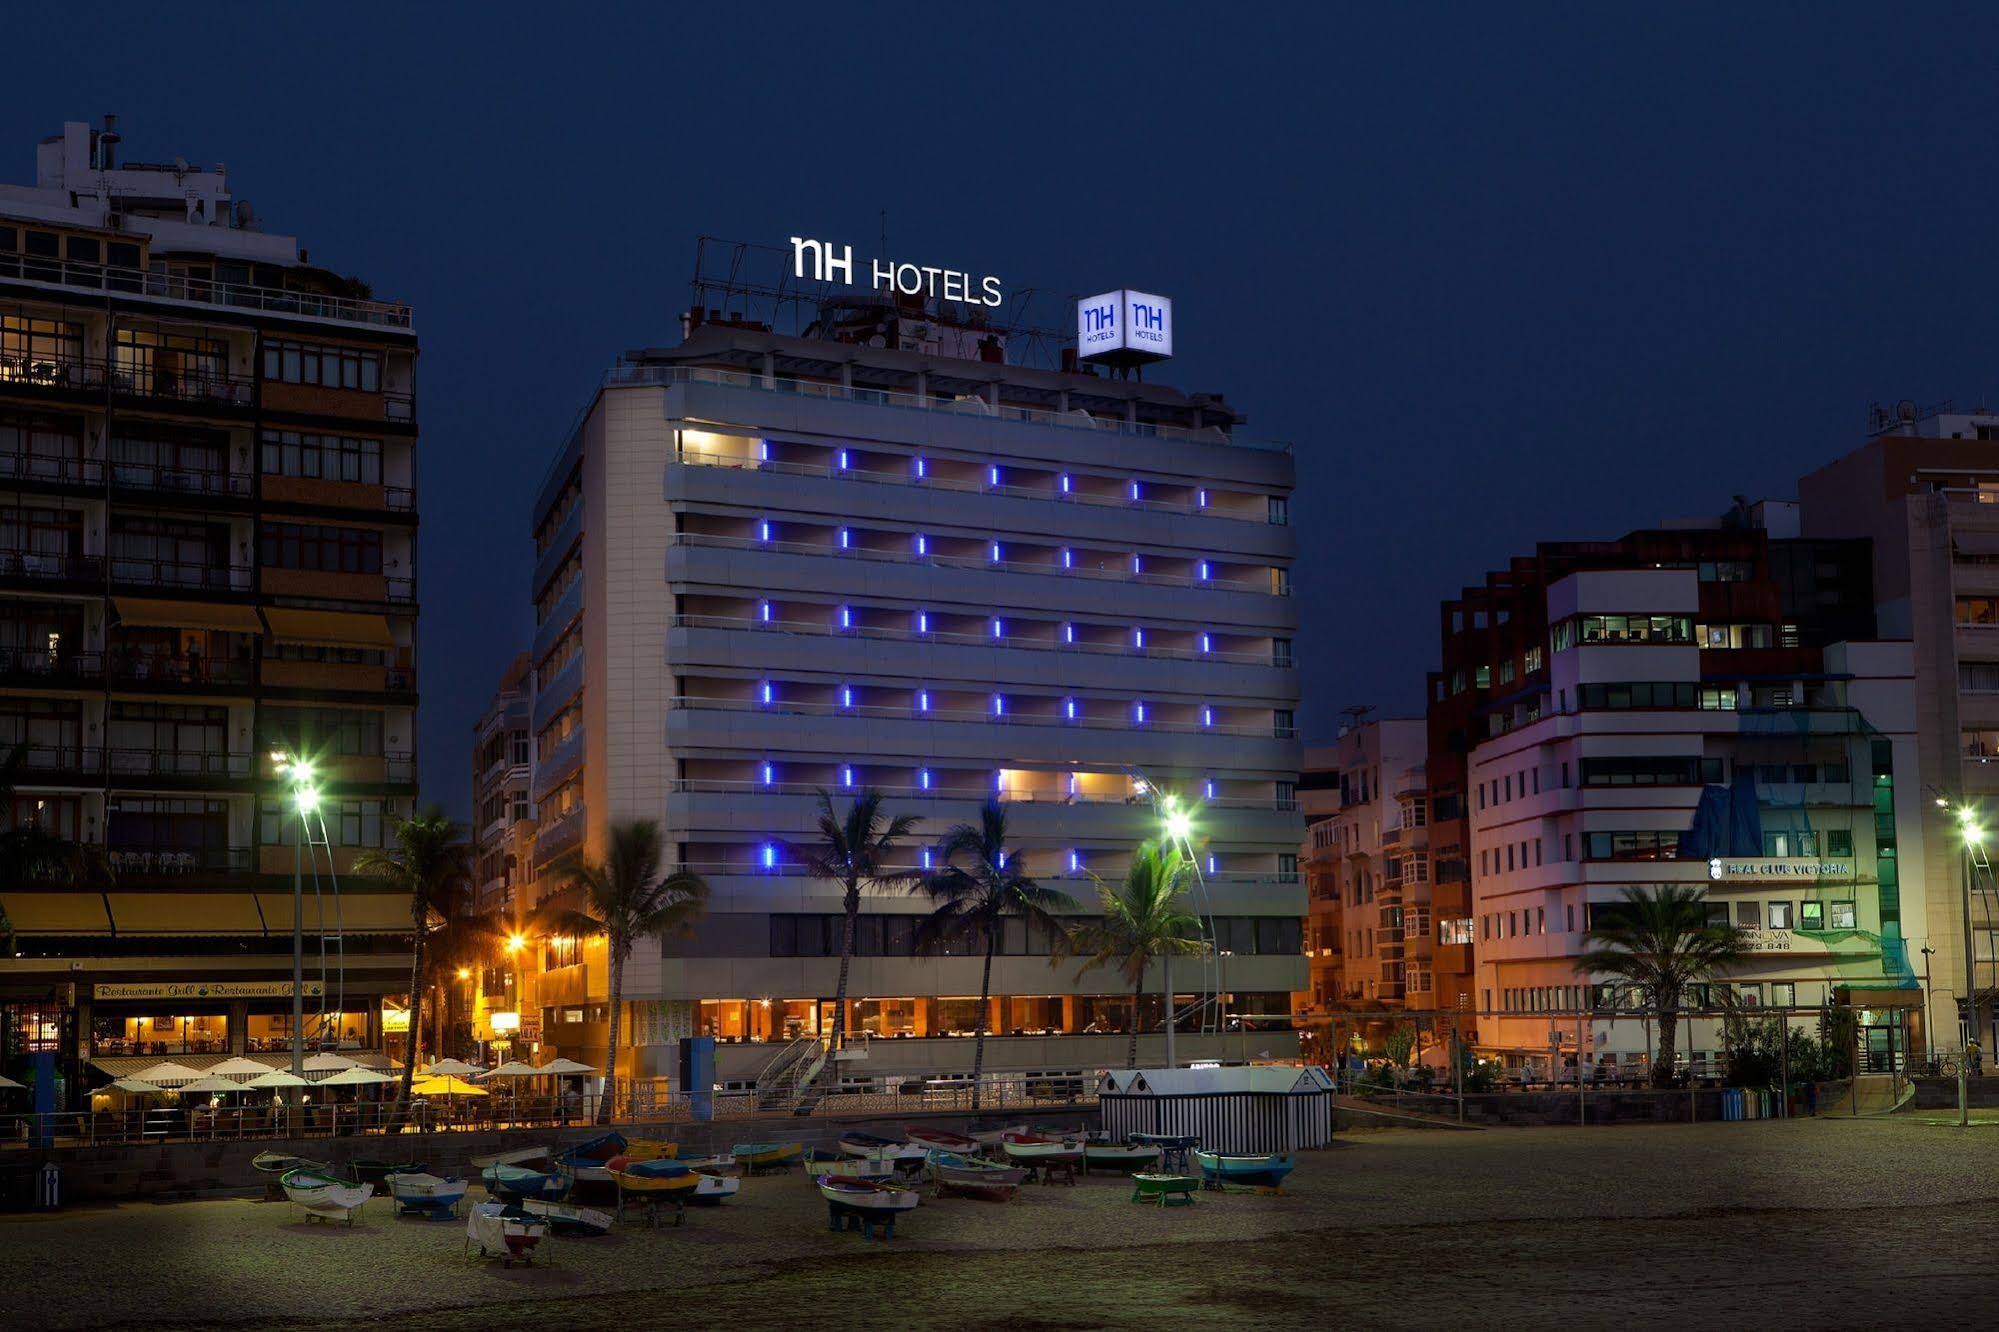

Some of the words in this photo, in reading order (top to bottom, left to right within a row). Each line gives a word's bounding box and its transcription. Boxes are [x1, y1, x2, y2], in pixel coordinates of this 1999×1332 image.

[873, 258, 1002, 307] HOTELS
[1087, 330, 1115, 344] HOTELS
[1135, 330, 1164, 343] HOTELS
[1727, 864, 1757, 875] REAL
[1793, 863, 1849, 875] VICTORIA
[1767, 942, 1790, 950] 848
[96, 985, 163, 997] Restaurante
[167, 984, 195, 996] Grill
[211, 984, 278, 996] Restaurante
